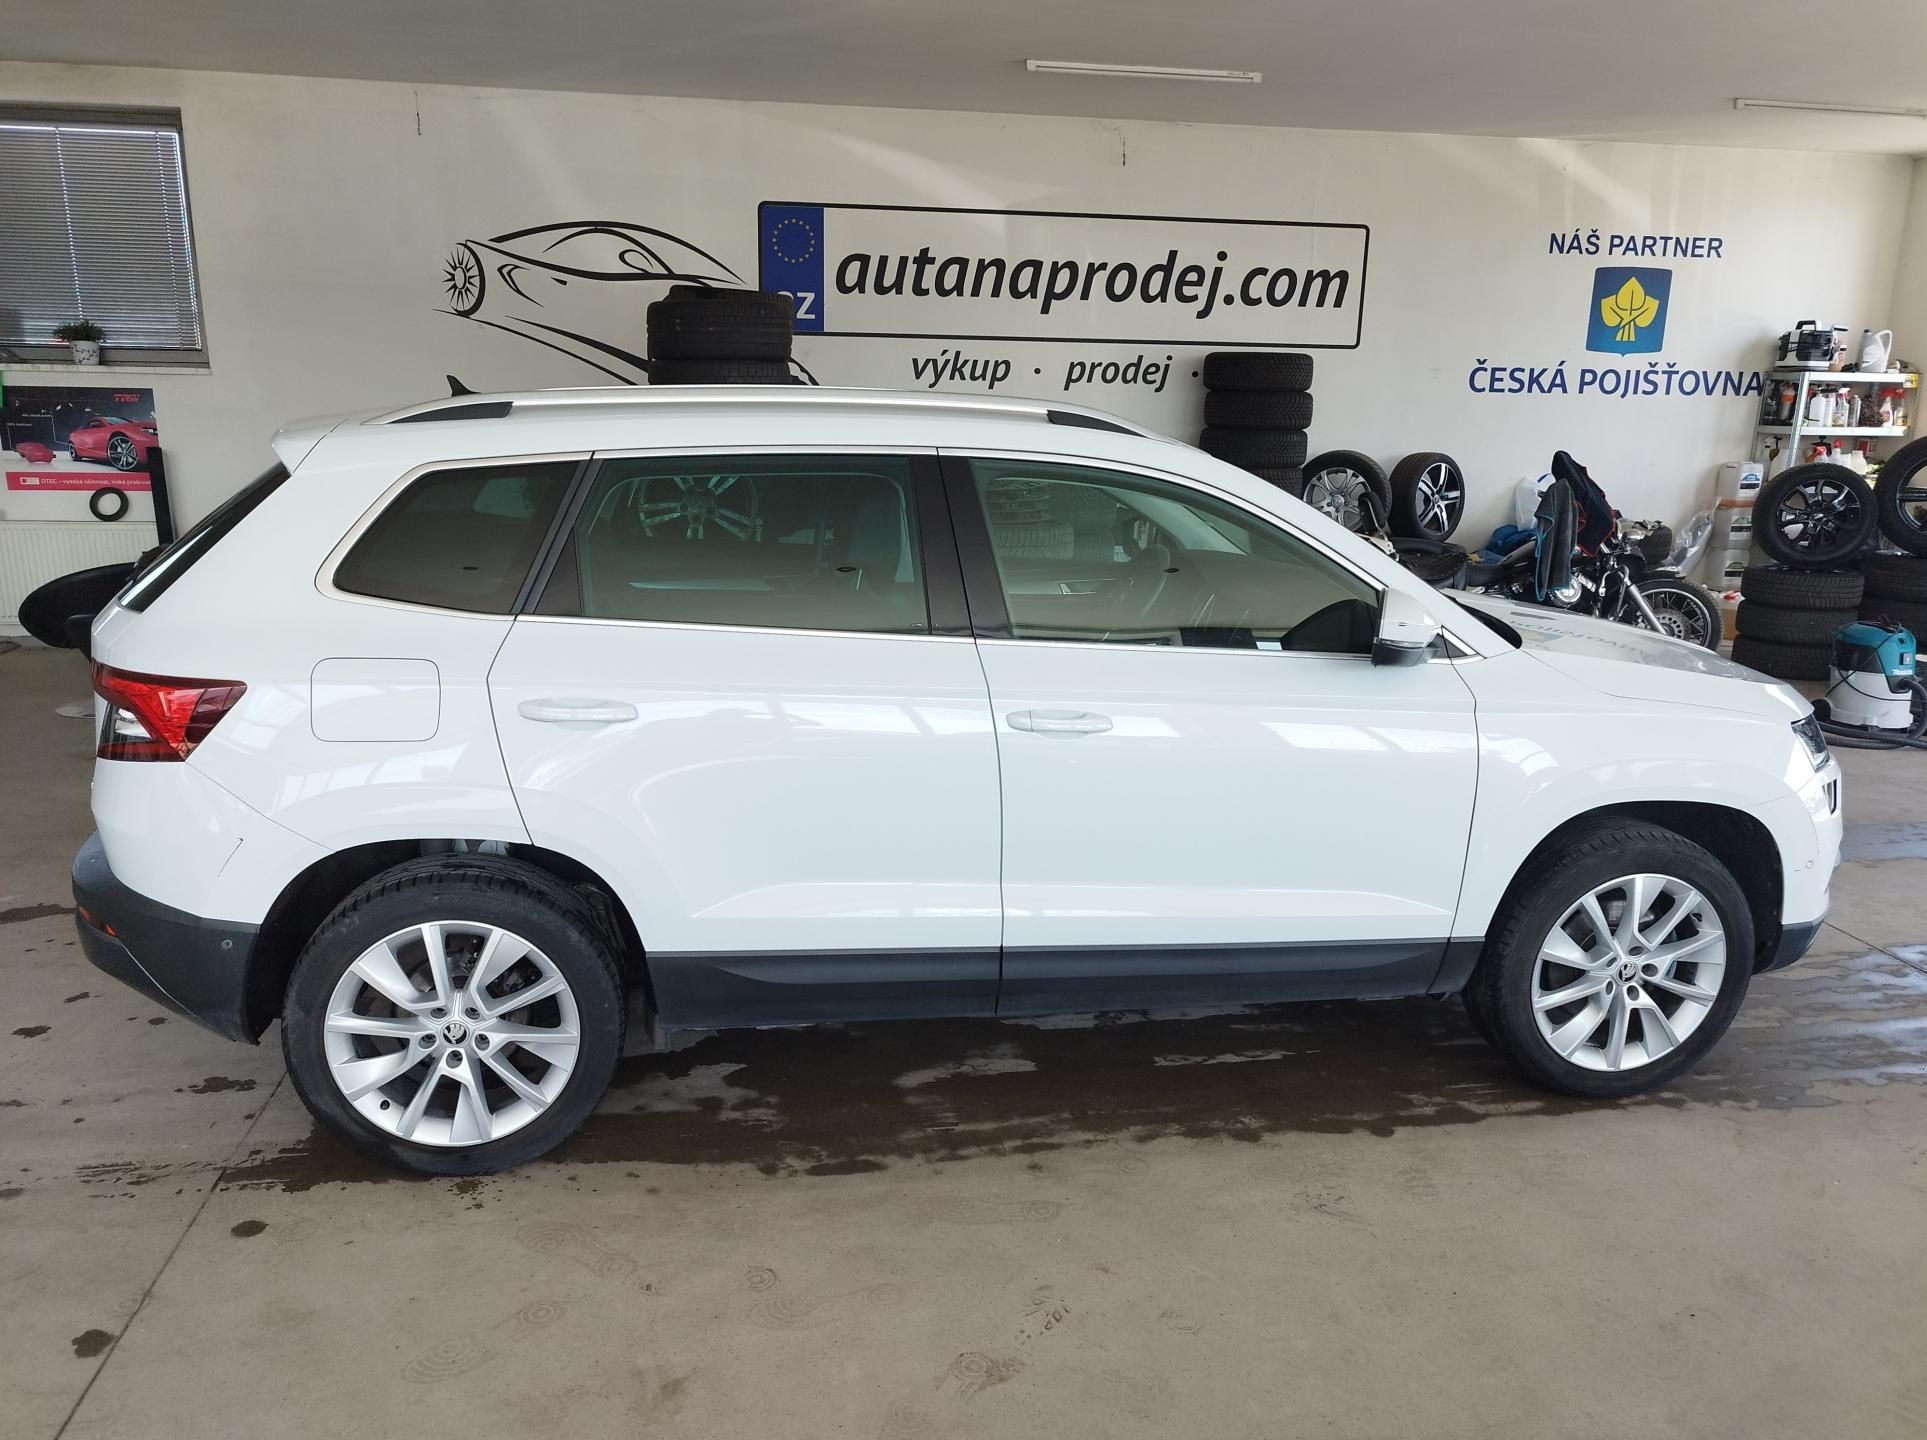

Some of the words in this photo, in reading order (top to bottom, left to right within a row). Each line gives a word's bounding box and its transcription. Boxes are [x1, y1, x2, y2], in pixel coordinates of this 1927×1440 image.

[1549, 228, 1600, 255] NÁŠ
[1608, 234, 1723, 258] PARTNER
[835, 246, 1349, 319] autanaprodej.com
[777, 291, 816, 319] Z
[911, 349, 1011, 390] výkup
[1063, 355, 1173, 392] prodej
[1469, 359, 1568, 394] ČESKÁ
[1578, 361, 1764, 399] POJIŠŤOVNA
